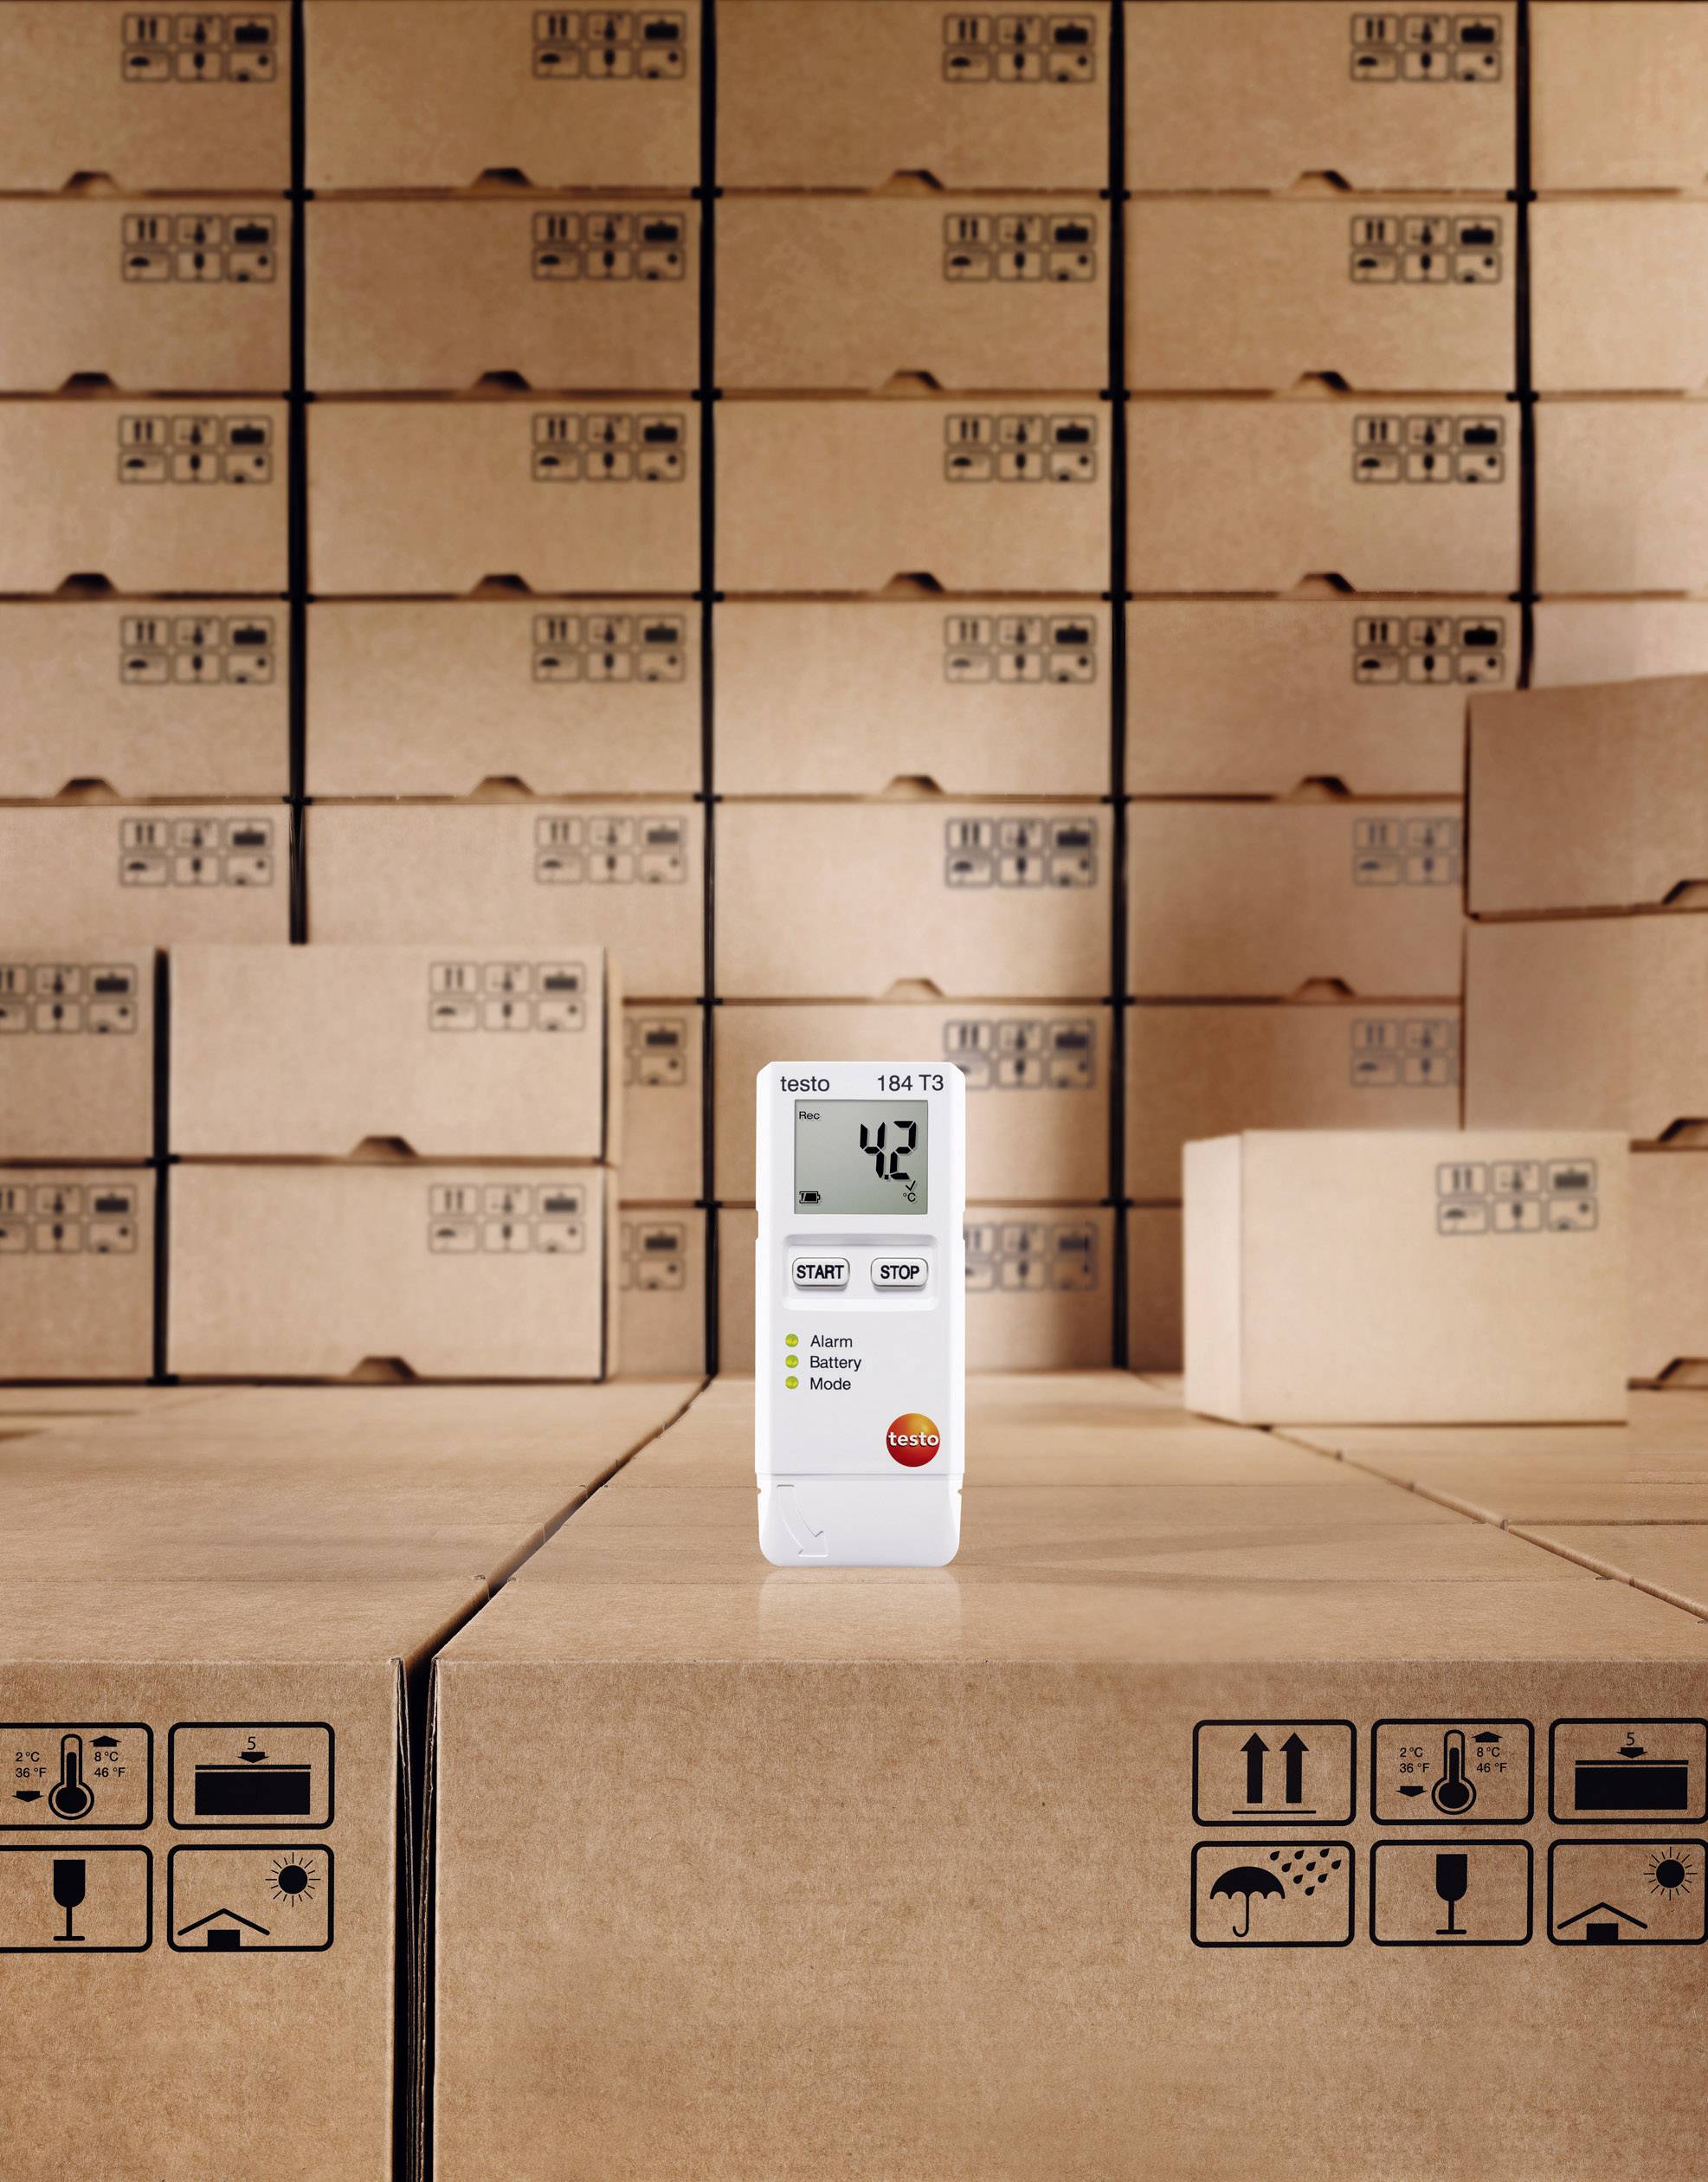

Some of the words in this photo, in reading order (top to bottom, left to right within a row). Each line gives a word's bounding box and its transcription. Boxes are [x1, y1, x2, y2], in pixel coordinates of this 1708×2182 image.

[780, 1075, 830, 1092] testo
[877, 1075, 913, 1092] 184
[918, 1075, 944, 1091] T3
[799, 1111, 821, 1120] Rec
[859, 1120, 917, 1180] 4.2
[796, 1264, 845, 1280] START
[880, 1264, 920, 1280] STOP
[810, 1334, 853, 1348] Alarm
[810, 1355, 862, 1372] Battery
[810, 1377, 852, 1391] Mode
[888, 1431, 939, 1447] testo
[247, 1736, 256, 1750] 5
[1627, 1732, 1635, 1746] 5
[16, 1767, 30, 1778] 36
[34, 1767, 47, 1778] °F
[93, 1767, 109, 1778] 46
[113, 1767, 126, 1778] °F
[1399, 1763, 1414, 1773] 36
[1417, 1763, 1430, 1773] °F
[1476, 1763, 1491, 1773] 46
[1494, 1763, 1507, 1773] °F
